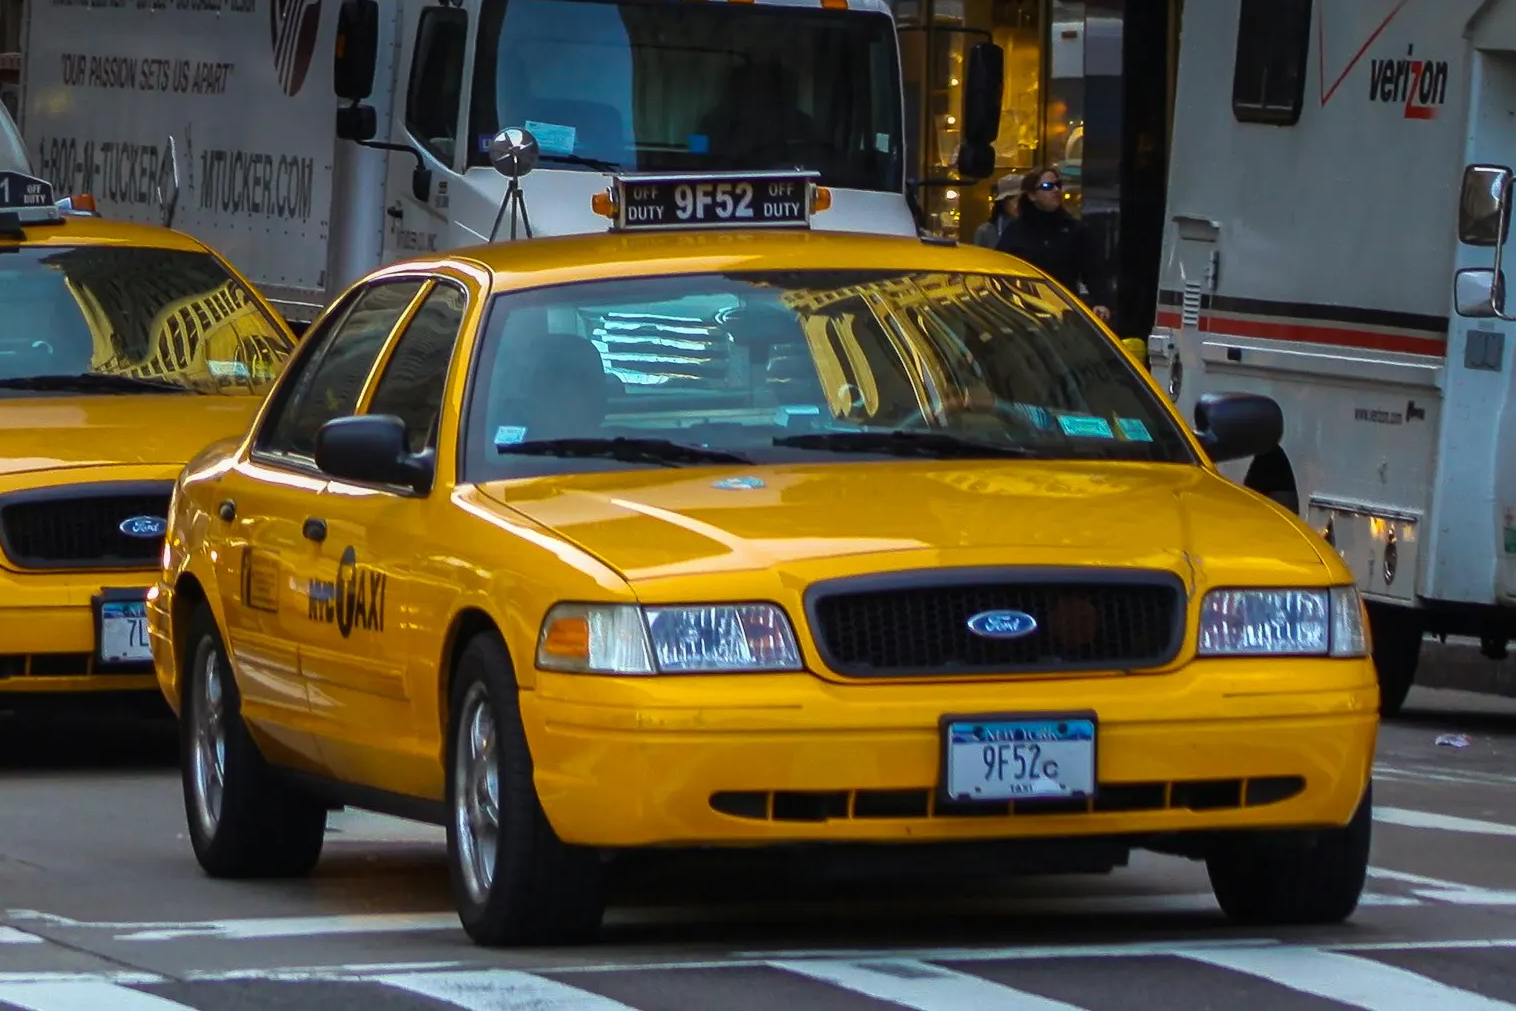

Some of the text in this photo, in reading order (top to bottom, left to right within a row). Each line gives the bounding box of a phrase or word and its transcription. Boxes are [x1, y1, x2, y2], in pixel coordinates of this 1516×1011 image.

[88, 55, 137, 90] PASSION
[139, 58, 169, 93] SETS
[173, 60, 189, 94] US
[1369, 43, 1448, 119] verizon
[26, 184, 41, 195] OFF
[633, 186, 659, 200] OFF
[767, 182, 795, 197] OFF
[23, 194, 46, 205] DUTY
[673, 181, 755, 221] 9F52
[627, 205, 665, 222] DUTY
[763, 202, 800, 218] DUTY
[131, 519, 161, 534] Ford
[335, 544, 387, 639] TAXI
[984, 615, 1021, 632] Ford
